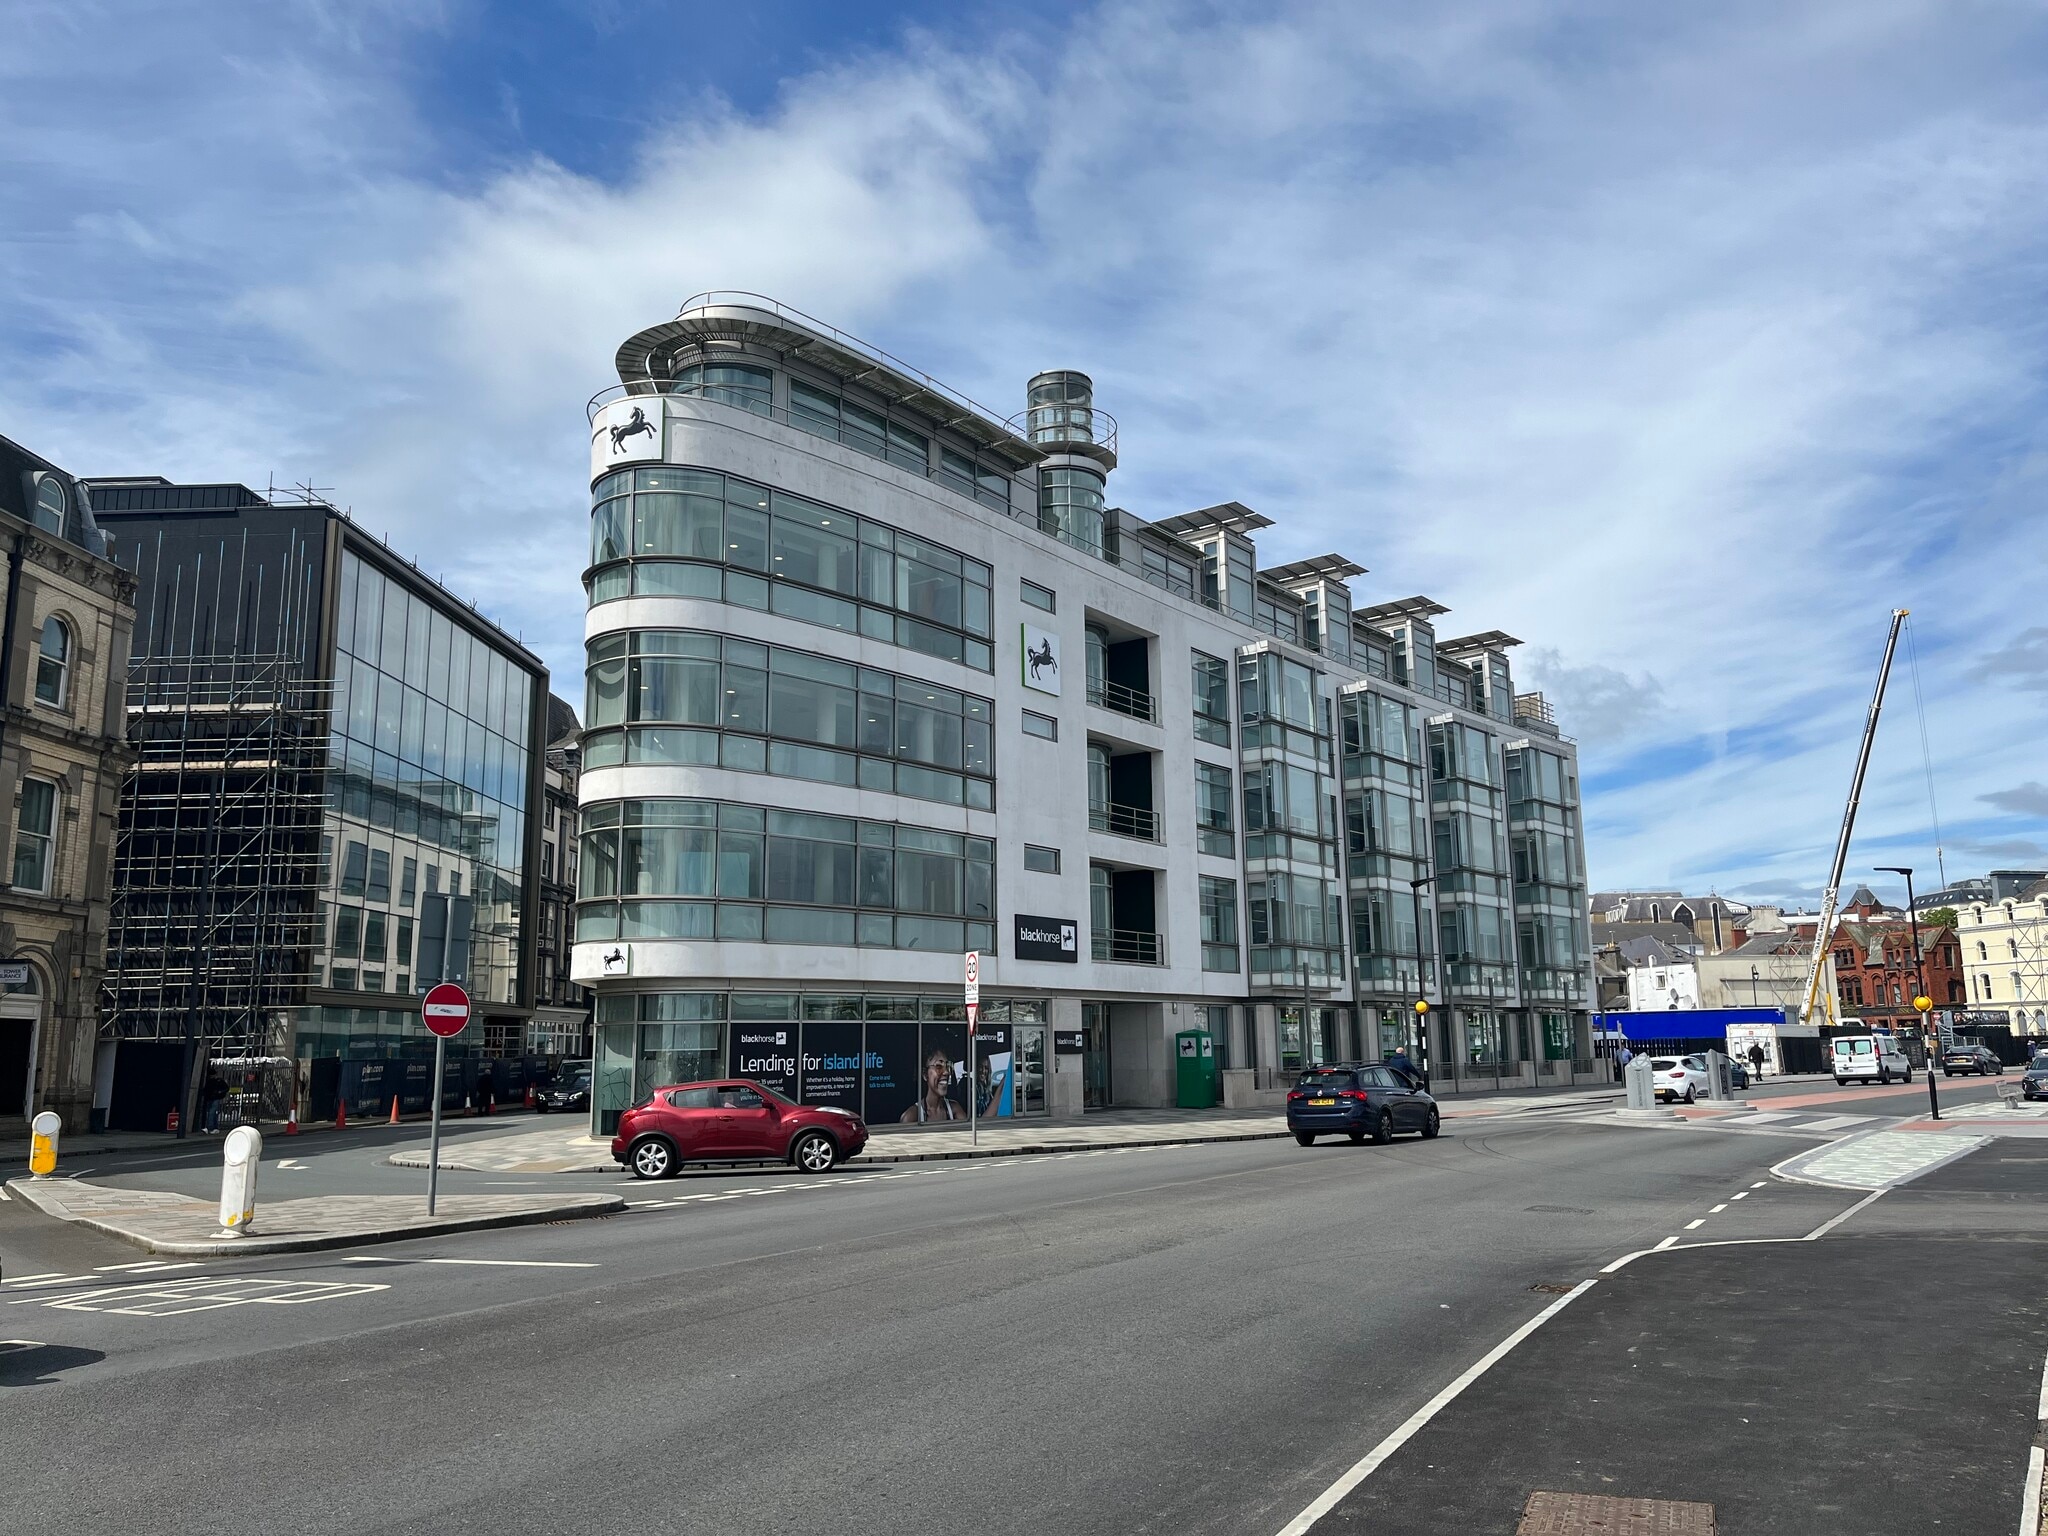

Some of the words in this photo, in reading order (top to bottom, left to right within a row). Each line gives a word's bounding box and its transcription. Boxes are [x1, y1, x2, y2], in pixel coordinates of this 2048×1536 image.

[1020, 927, 1061, 943] blackhorse
[968, 962, 976, 974] 20
[966, 984, 977, 992] ZONE
[741, 1034, 775, 1043] blackhorse
[740, 1053, 795, 1076] Lending
[802, 1052, 822, 1070] for
[823, 1052, 860, 1070] island
[865, 1052, 884, 1069] life
